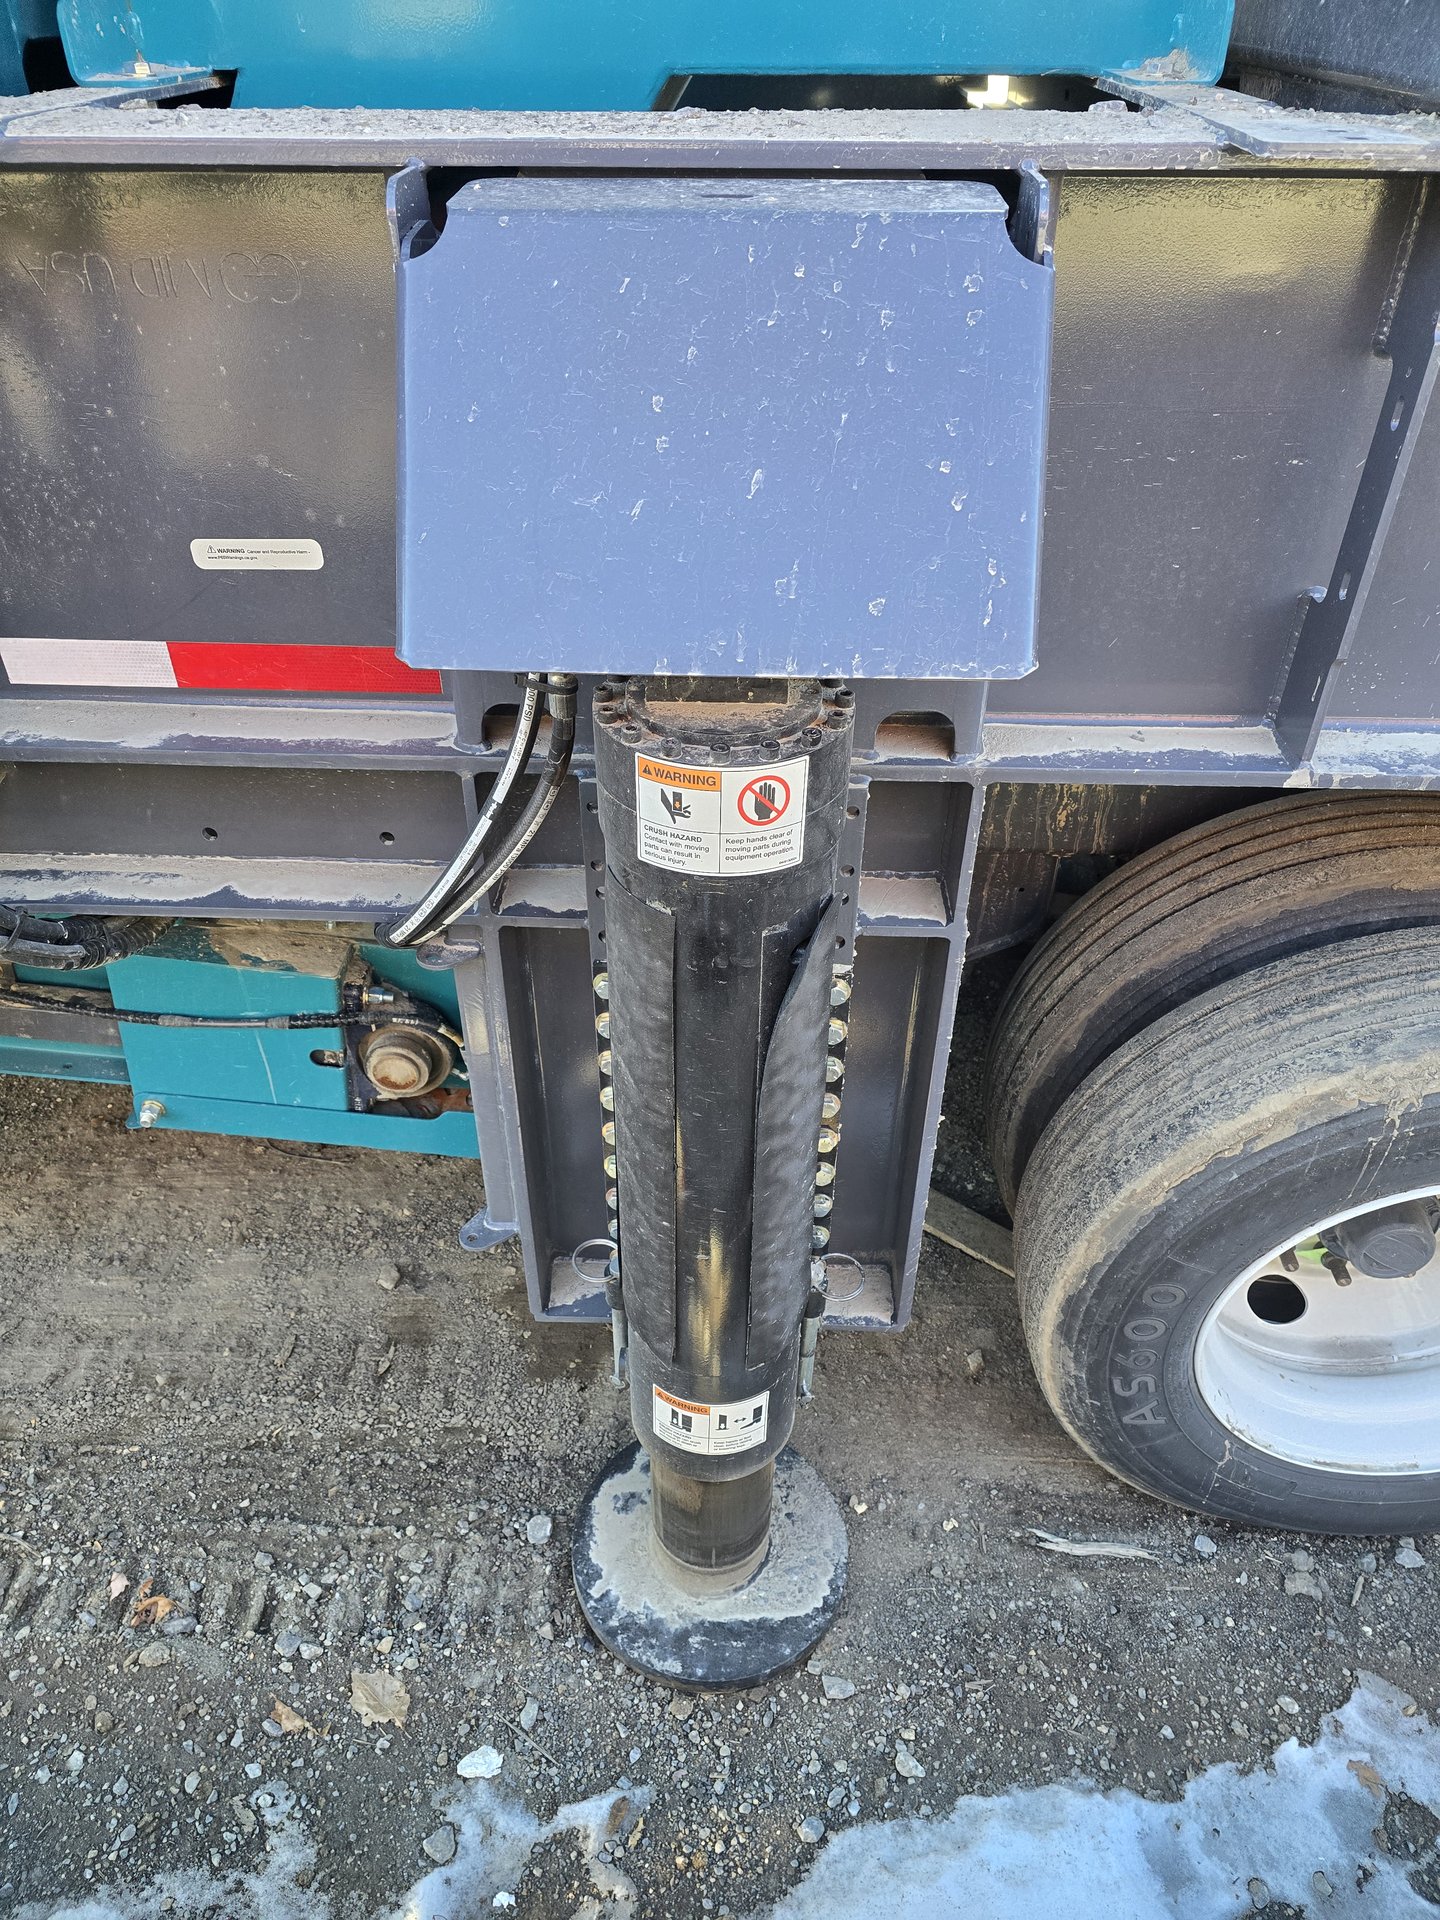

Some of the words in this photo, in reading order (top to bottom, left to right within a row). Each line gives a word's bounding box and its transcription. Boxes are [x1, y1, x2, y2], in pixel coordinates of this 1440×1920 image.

[15, 251, 118, 297] USA
[524, 704, 534, 722] PSI)
[653, 766, 717, 787] WARNING
[643, 824, 668, 837] CRUSH
[670, 830, 703, 843] HAZARD
[725, 837, 745, 845] Keep
[746, 835, 768, 844] hands
[769, 830, 785, 841] clear
[786, 828, 794, 836] of
[644, 833, 668, 846] Contact
[668, 839, 683, 849] with
[684, 843, 710, 853] moving
[644, 842, 659, 851] parts
[660, 847, 673, 855] can
[674, 849, 693, 859] result
[725, 845, 751, 853] moving
[752, 842, 770, 852] parts
[771, 839, 792, 848] during
[644, 850, 667, 861] serious
[667, 856, 687, 867] injury.
[724, 853, 762, 862] equipment
[763, 846, 795, 858] operation.
[1110, 1283, 1189, 1425] AS600
[663, 1396, 708, 1413] WARNING
